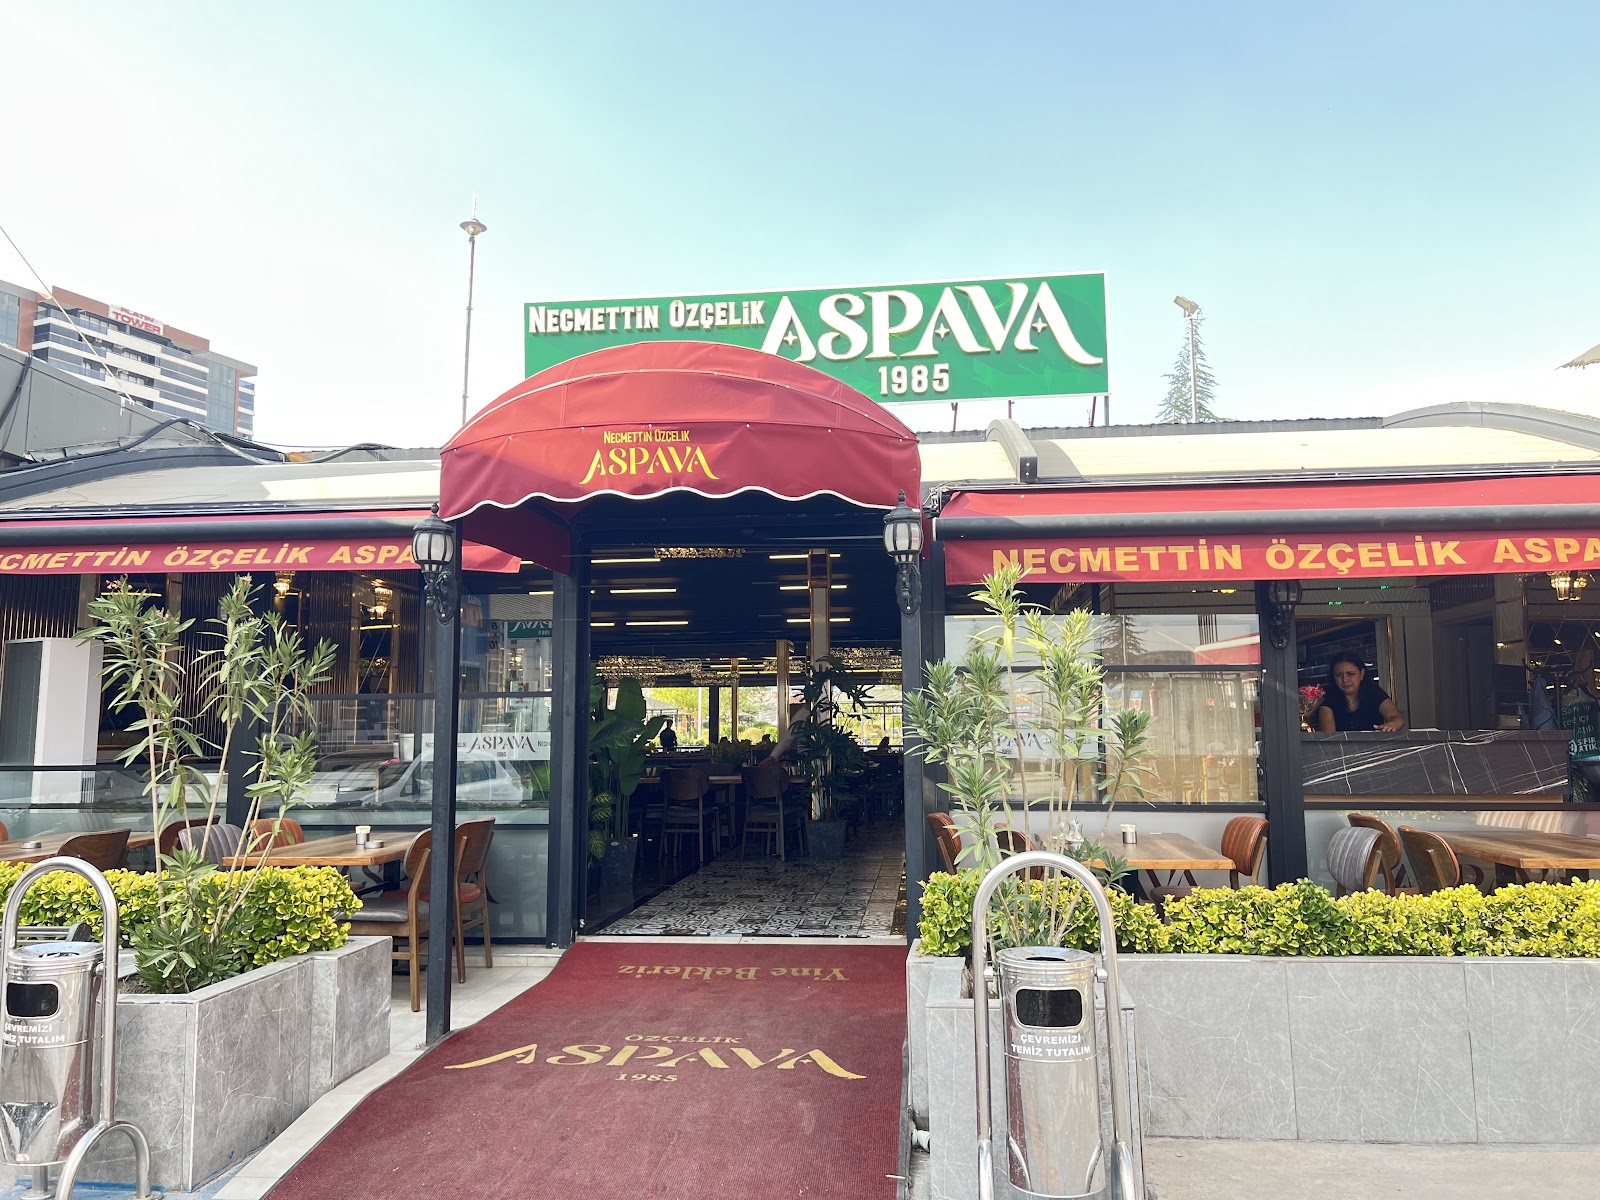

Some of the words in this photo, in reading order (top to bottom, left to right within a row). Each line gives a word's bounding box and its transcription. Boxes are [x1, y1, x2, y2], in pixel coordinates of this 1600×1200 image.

[112, 311, 161, 333] TOWER
[760, 280, 1104, 366] ASPAVA
[878, 362, 950, 396] 1985
[579, 446, 720, 485] ASPAVA
[0, 546, 152, 571] CMETTİN
[163, 543, 315, 569] ÖZÇELİK
[327, 545, 416, 565] ASPA
[992, 538, 1243, 575] NECMETTİN
[1265, 535, 1467, 575] ÖZÇELİK
[1493, 537, 1600, 563] ASPA
[467, 735, 538, 753] ASPAVA
[618, 965, 761, 981] Bekleriz
[771, 967, 850, 982] Yine
[18, 1034, 66, 1044] TUTALIM
[1020, 1033, 1081, 1045] ÇEVREMİZİ
[1011, 1043, 1043, 1057] TEMİZ
[1045, 1045, 1091, 1057] TUTALIM
[444, 1043, 867, 1080] ASPAVA
[614, 1073, 678, 1082] 1985
